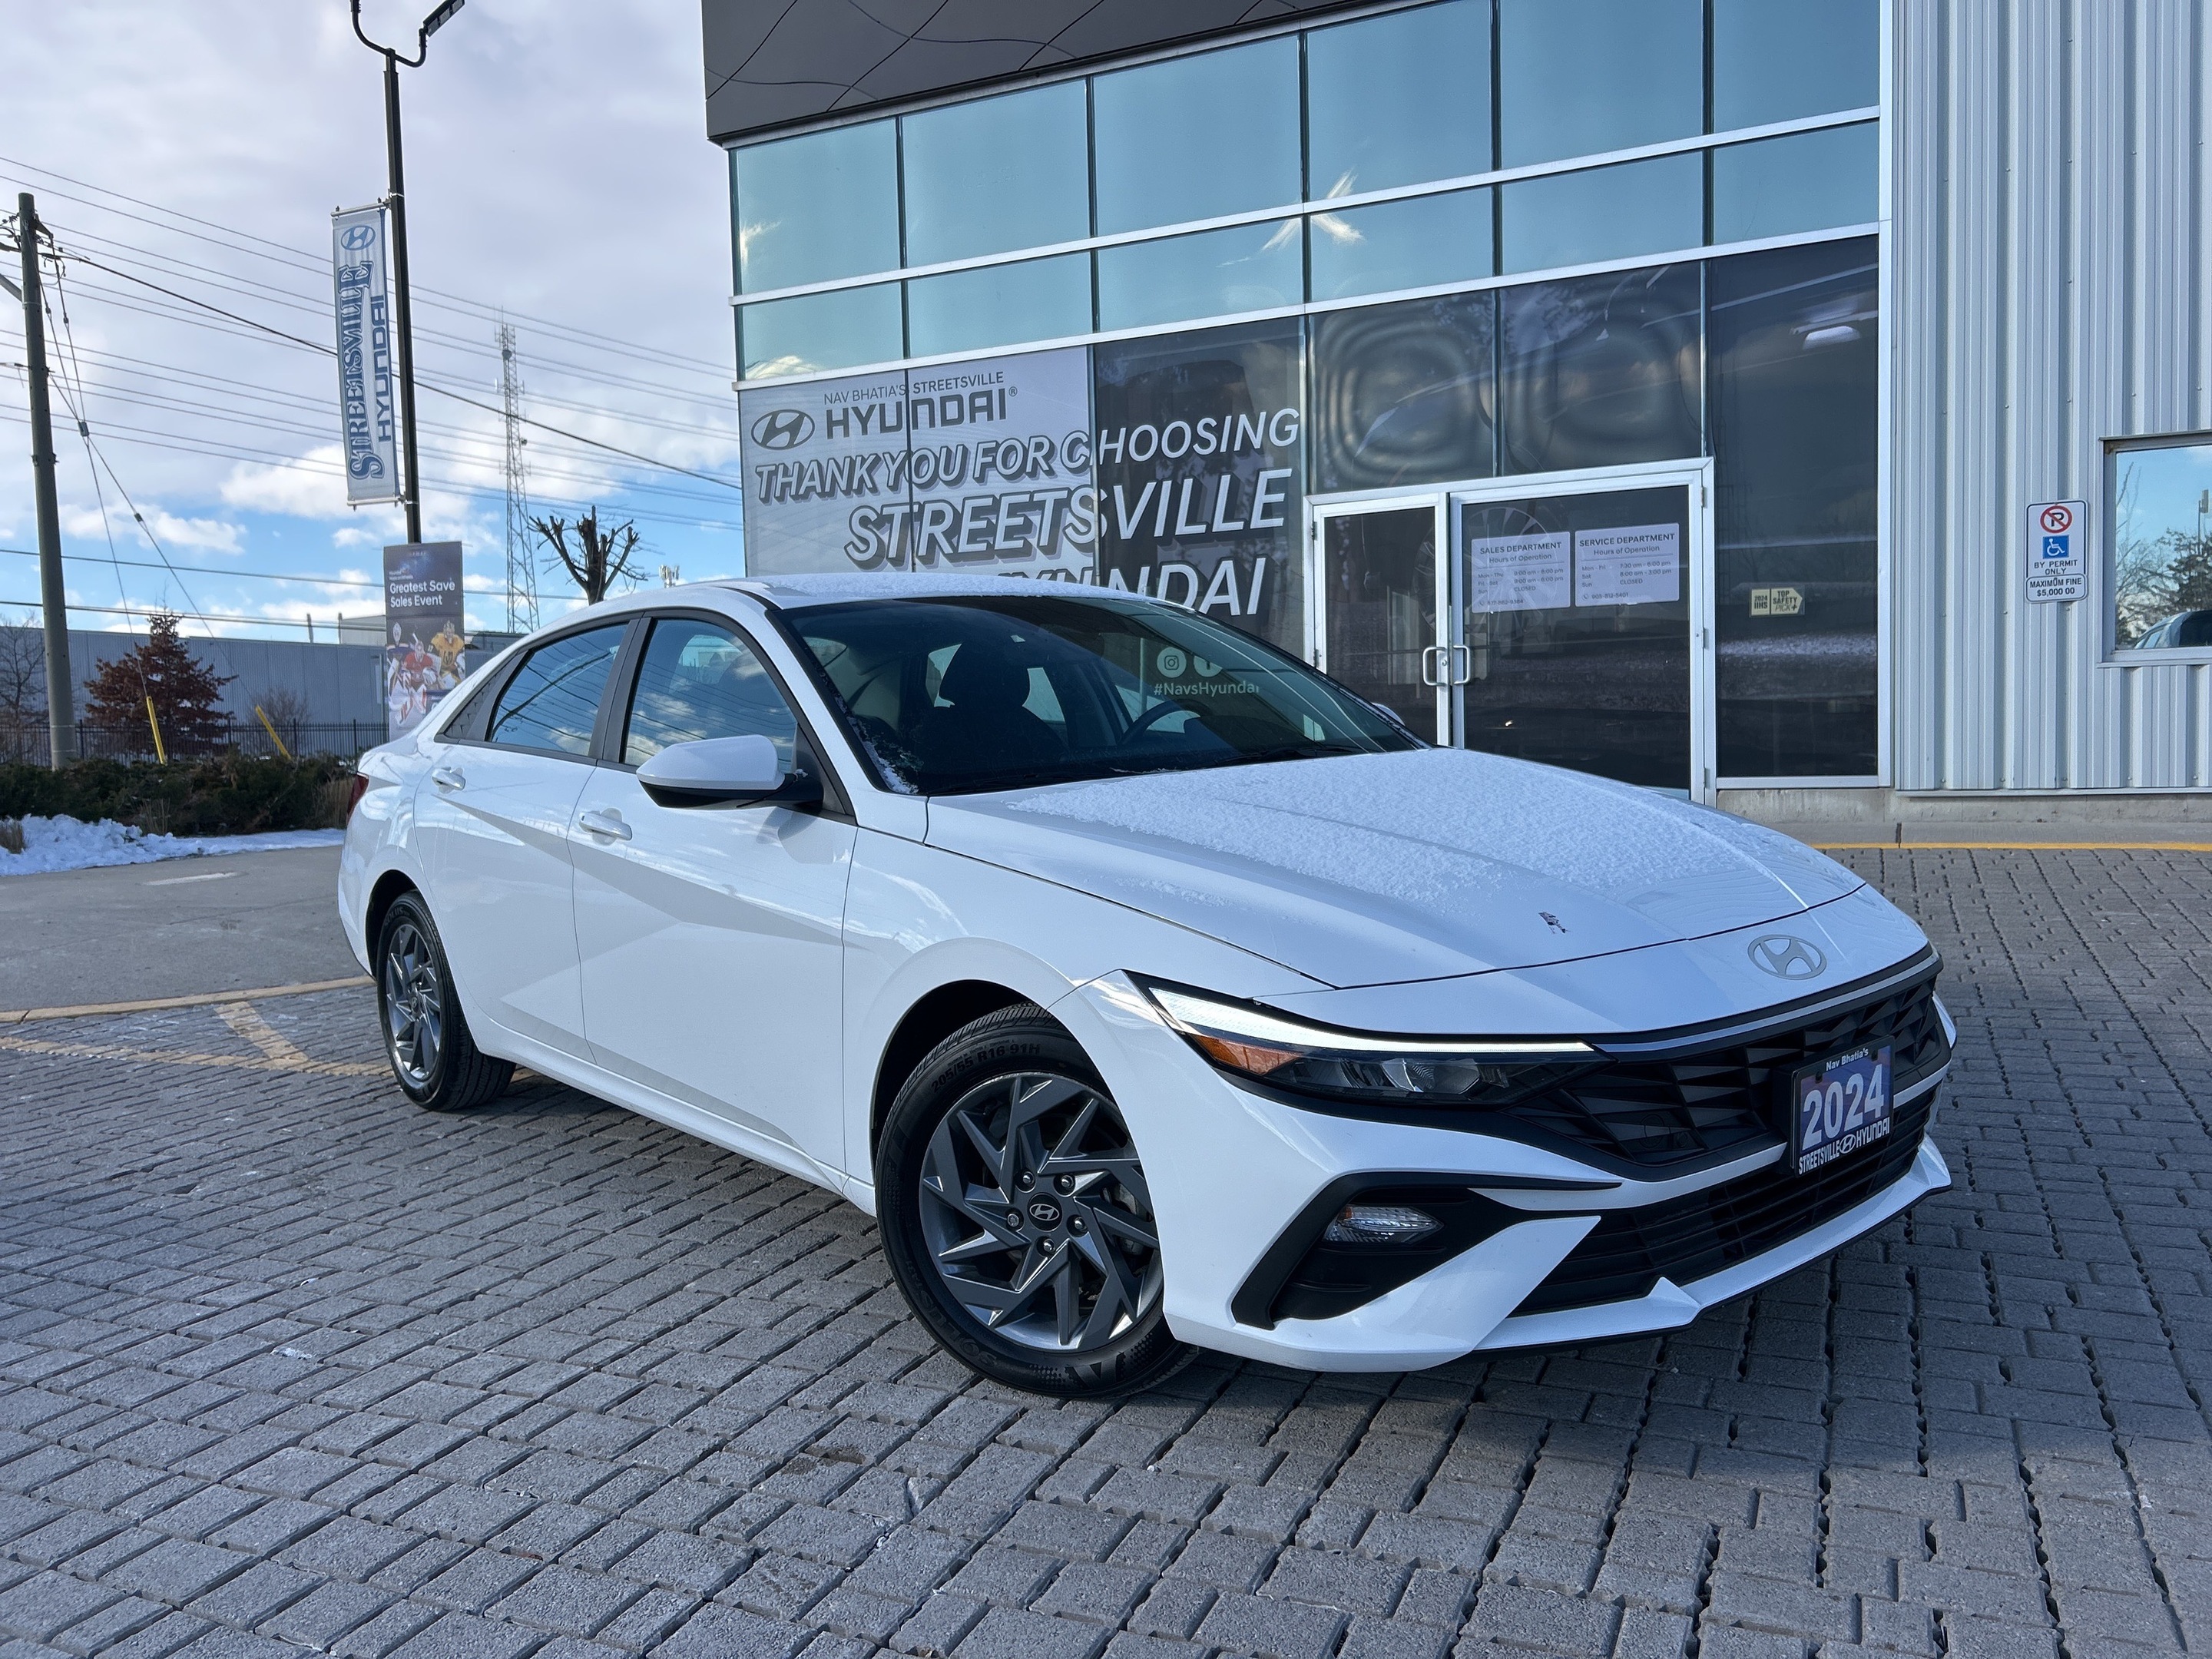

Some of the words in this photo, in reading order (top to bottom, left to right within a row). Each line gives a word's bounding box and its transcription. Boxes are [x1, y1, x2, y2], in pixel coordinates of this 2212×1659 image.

[337, 260, 385, 480] STREETSVILLE
[370, 295, 392, 443] HYUNDAI
[824, 391, 849, 405] NAV
[853, 384, 906, 402] BHATIA'S
[912, 372, 1004, 394] STREETSVILLE
[755, 453, 884, 505] THANK
[882, 444, 971, 492] YOU
[972, 435, 1056, 485] FOR
[1060, 408, 1300, 475] CHOOSING
[844, 468, 1293, 571] STREETSVILLE
[1480, 545, 1505, 555] SALES
[1506, 541, 1561, 553] DEPARTMENT
[1579, 537, 1614, 547] SERVICE
[1617, 533, 1675, 545] DEPARTMENT
[1488, 555, 1508, 564] Hours
[1518, 553, 1552, 562] Operation
[1594, 547, 1614, 555] Hours
[1624, 545, 1660, 555] Operation
[2049, 559, 2078, 568] PERMIT
[389, 580, 427, 594] Greatest
[429, 579, 455, 592] Save
[2030, 578, 2064, 588] MAXIMUM
[390, 595, 412, 608] Sales
[414, 594, 443, 606] Event
[1773, 596, 1797, 604] SAFETY
[930, 1056, 975, 1094] 205/55
[976, 1045, 1006, 1063] R16
[1009, 1043, 1041, 1055] 91H
[1826, 1059, 1840, 1071] Nav
[1841, 1048, 1869, 1065] Bhatia's
[1802, 1064, 1884, 1151] 2024
[1798, 1139, 1840, 1175] STREETSVILLE
[1856, 1116, 1890, 1148] HYUNDAI
